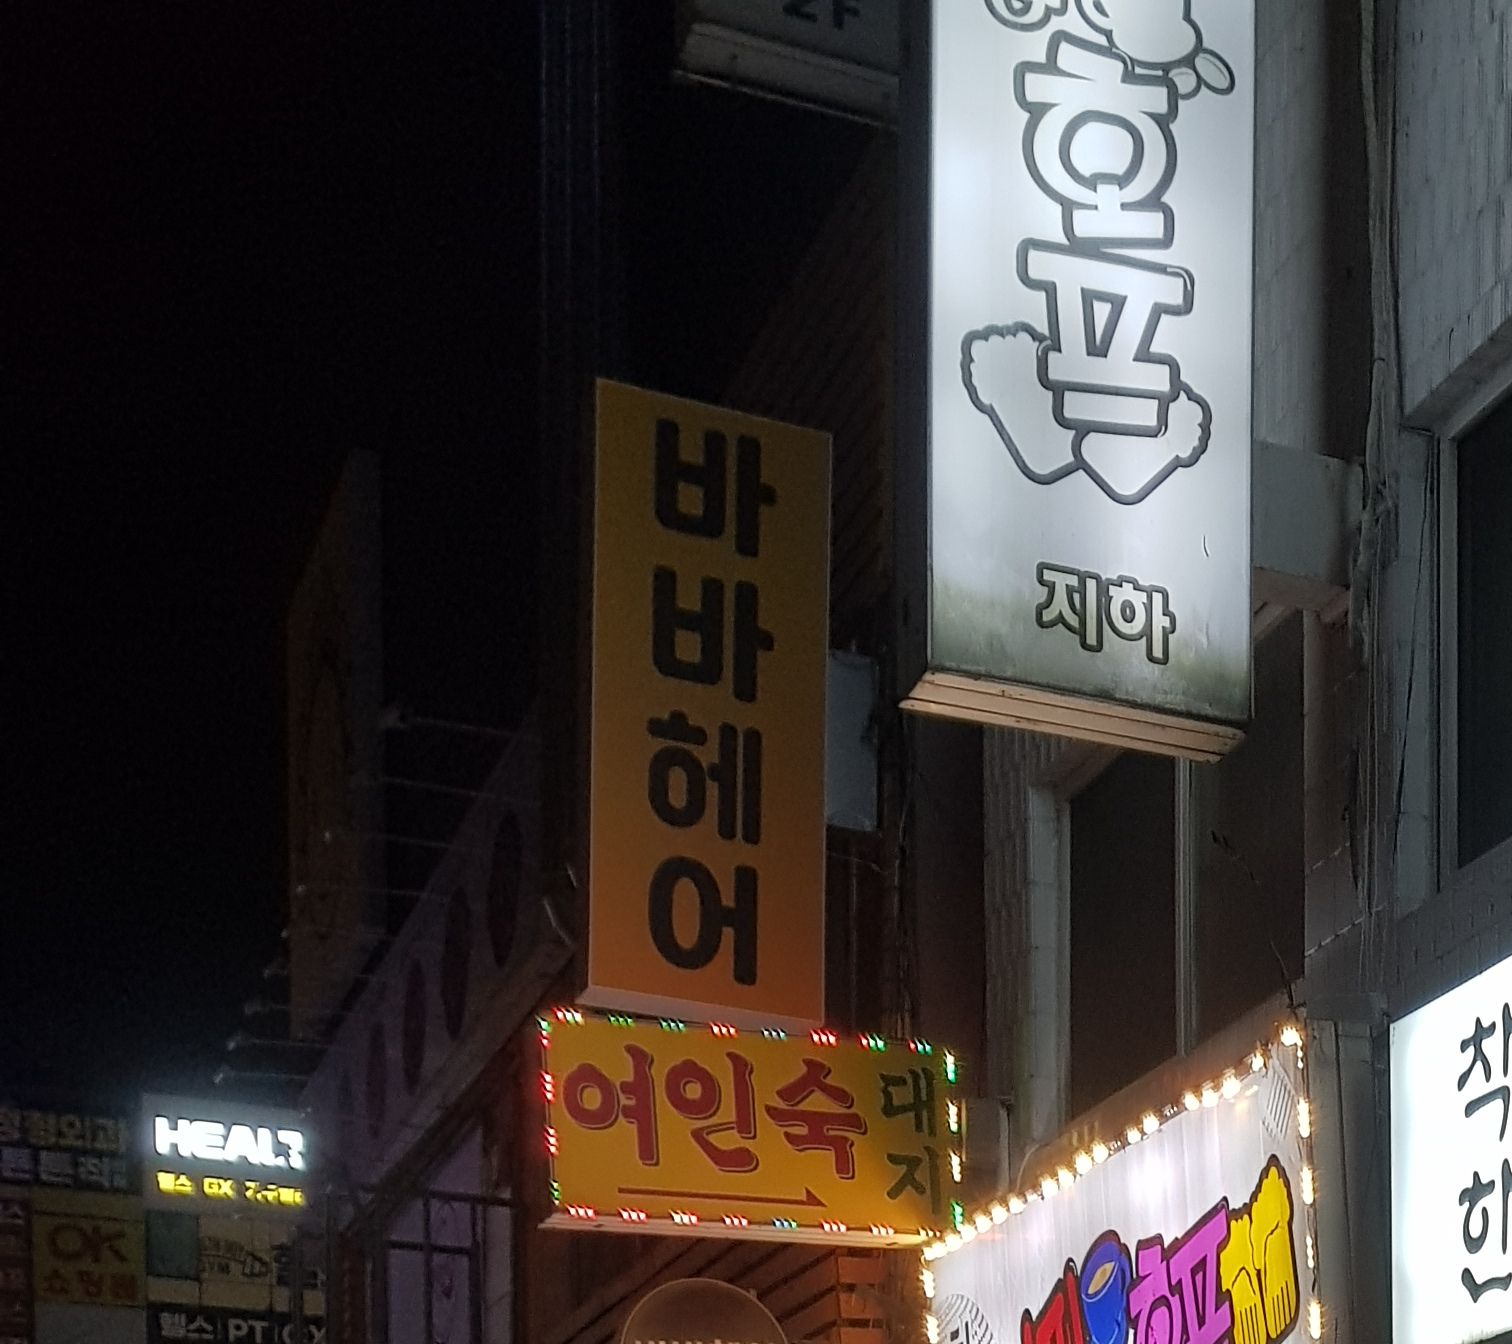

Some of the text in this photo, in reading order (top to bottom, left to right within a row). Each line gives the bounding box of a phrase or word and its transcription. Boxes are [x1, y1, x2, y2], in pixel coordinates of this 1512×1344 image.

[1013, 29, 1196, 437] 호프
[1036, 561, 1176, 664] 지하
[646, 417, 777, 988] 바바헤어
[561, 1043, 868, 1181] 여인숙
[879, 1061, 942, 1216] 대지
[47, 1222, 128, 1263] OK
[202, 1175, 235, 1200] GX
[159, 1311, 216, 1340] 헬스
